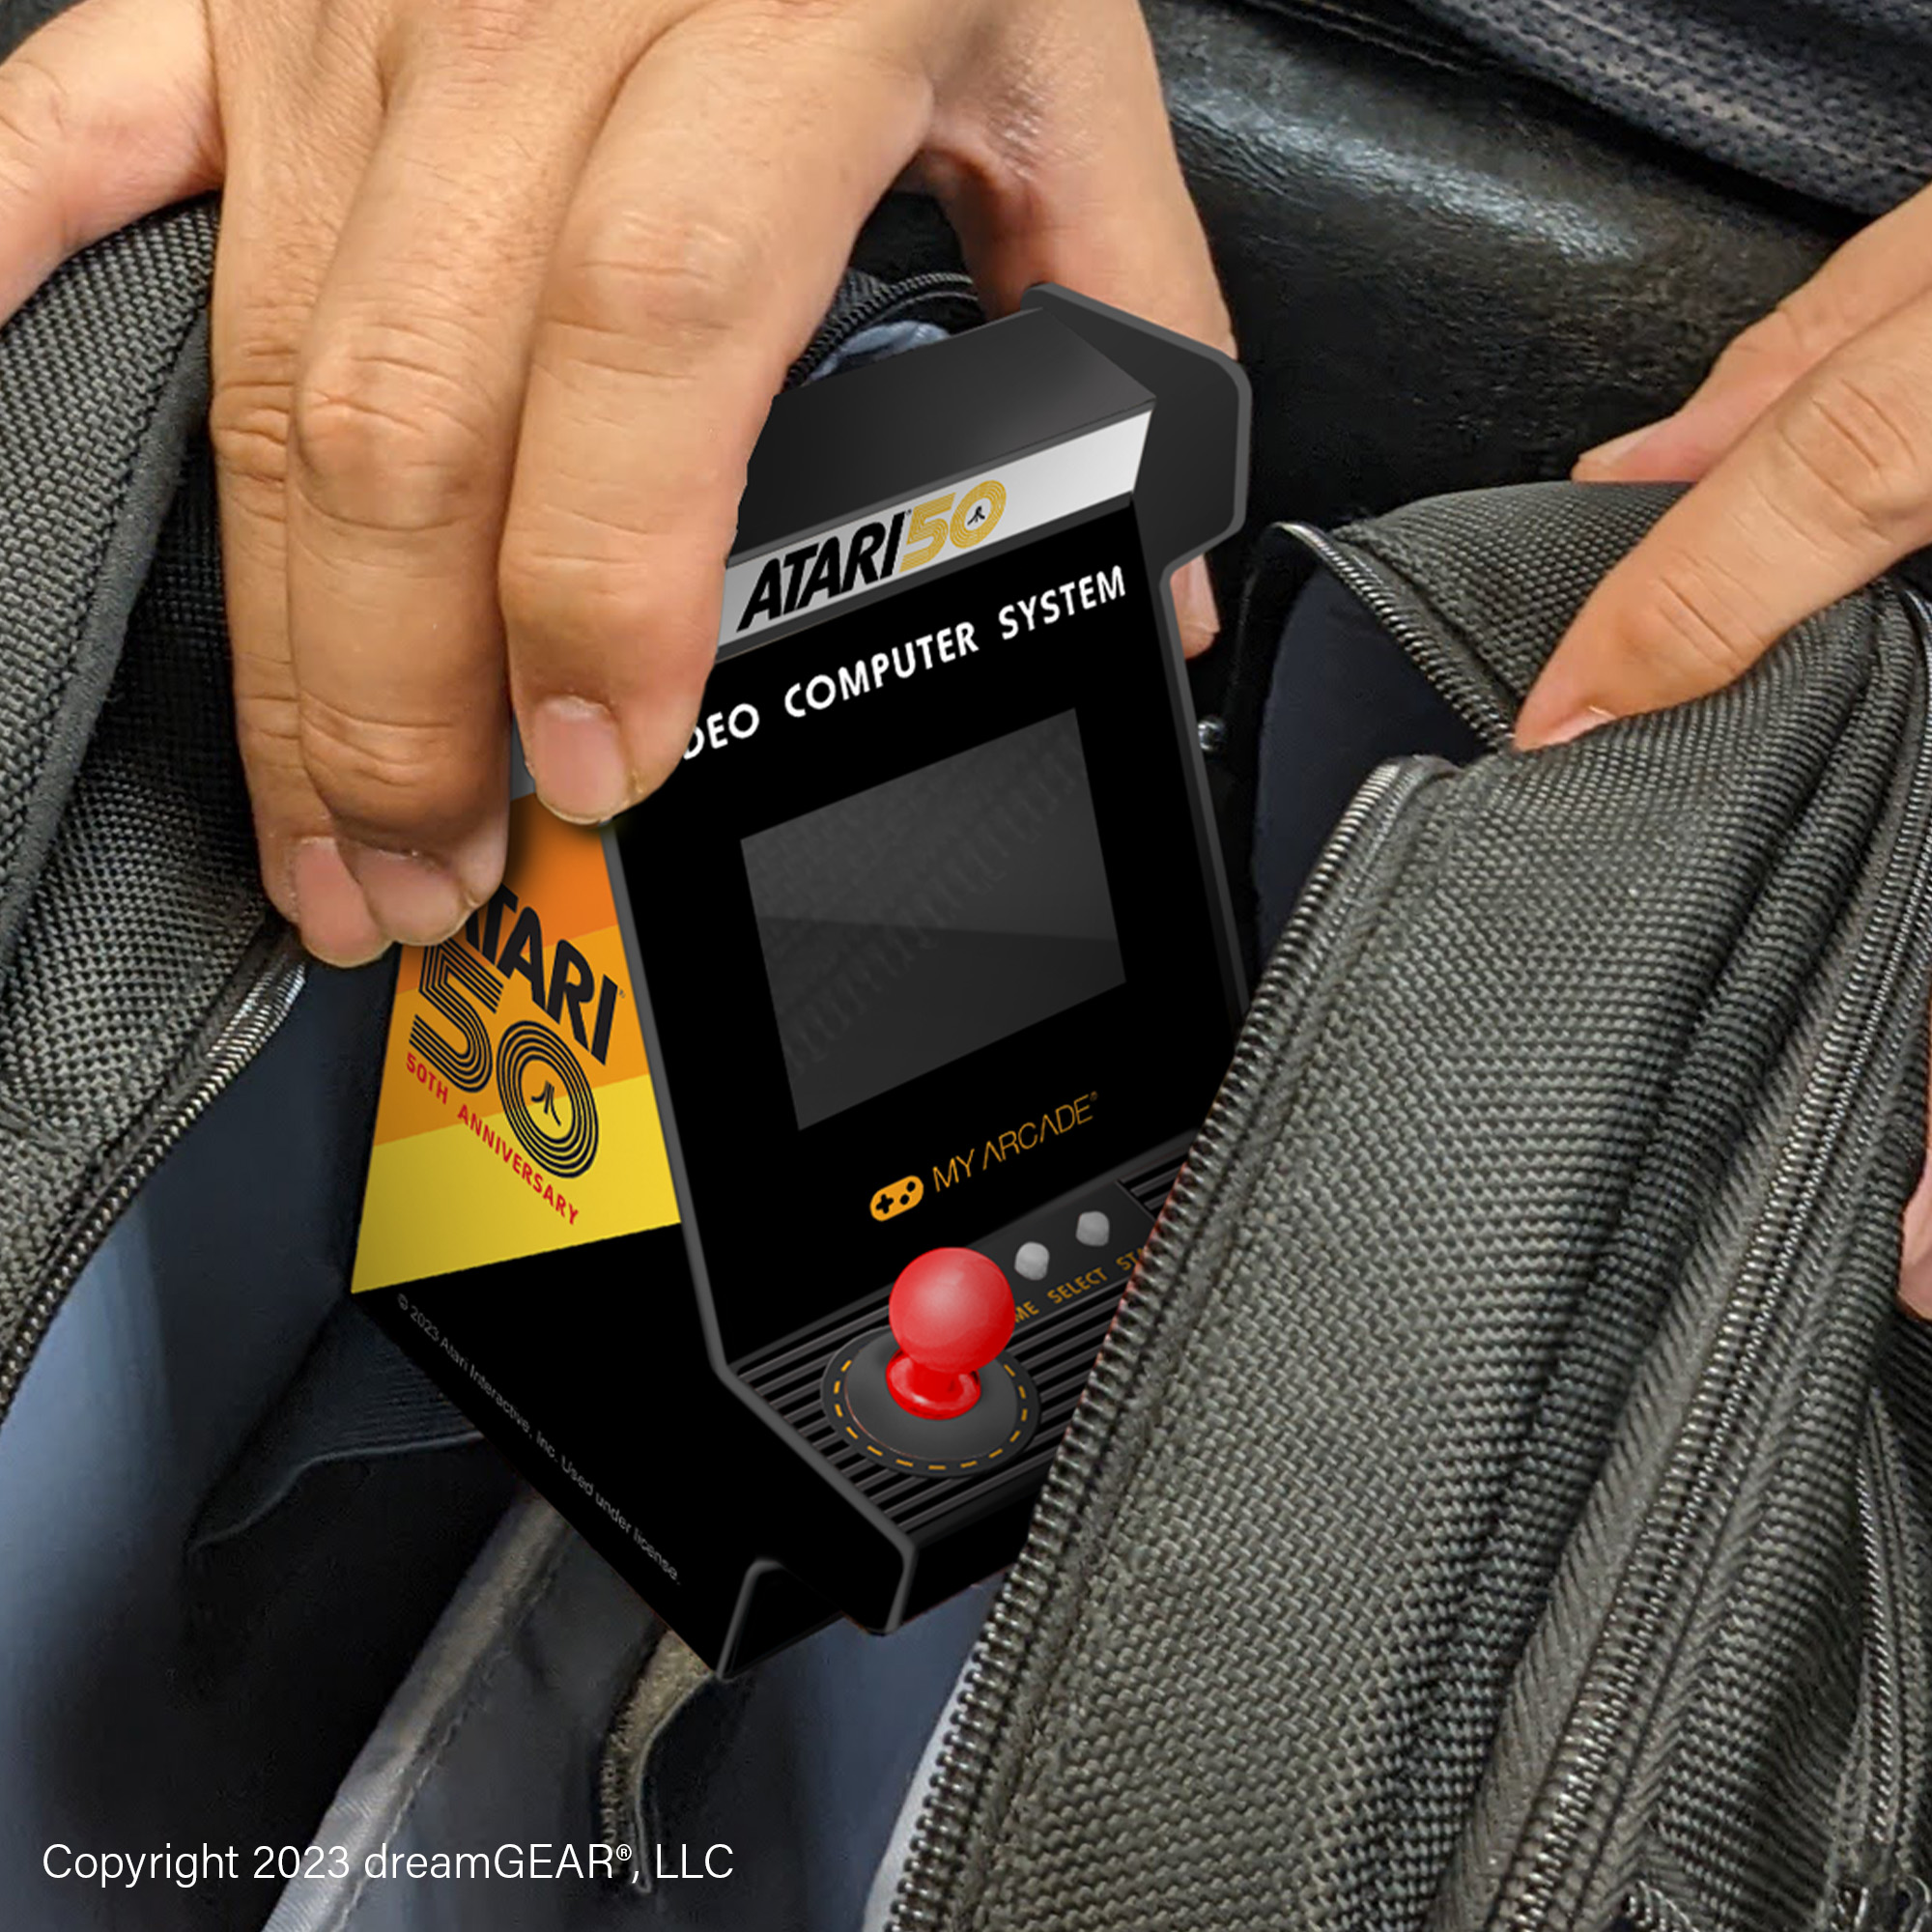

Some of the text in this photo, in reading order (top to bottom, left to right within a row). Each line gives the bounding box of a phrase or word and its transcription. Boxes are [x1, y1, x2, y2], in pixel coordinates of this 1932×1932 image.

[736, 510, 906, 633] ATARI
[683, 565, 1126, 760] DEO COMPUTER SYSTEM
[406, 1052, 579, 1225] 50TH ANNIVERSARY
[932, 1148, 976, 1193] MY
[1046, 1266, 1108, 1304] SELECT
[410, 1305, 440, 1342] 2023
[440, 1337, 469, 1372] Atari
[560, 1455, 595, 1496] Used
[595, 1492, 632, 1533] under
